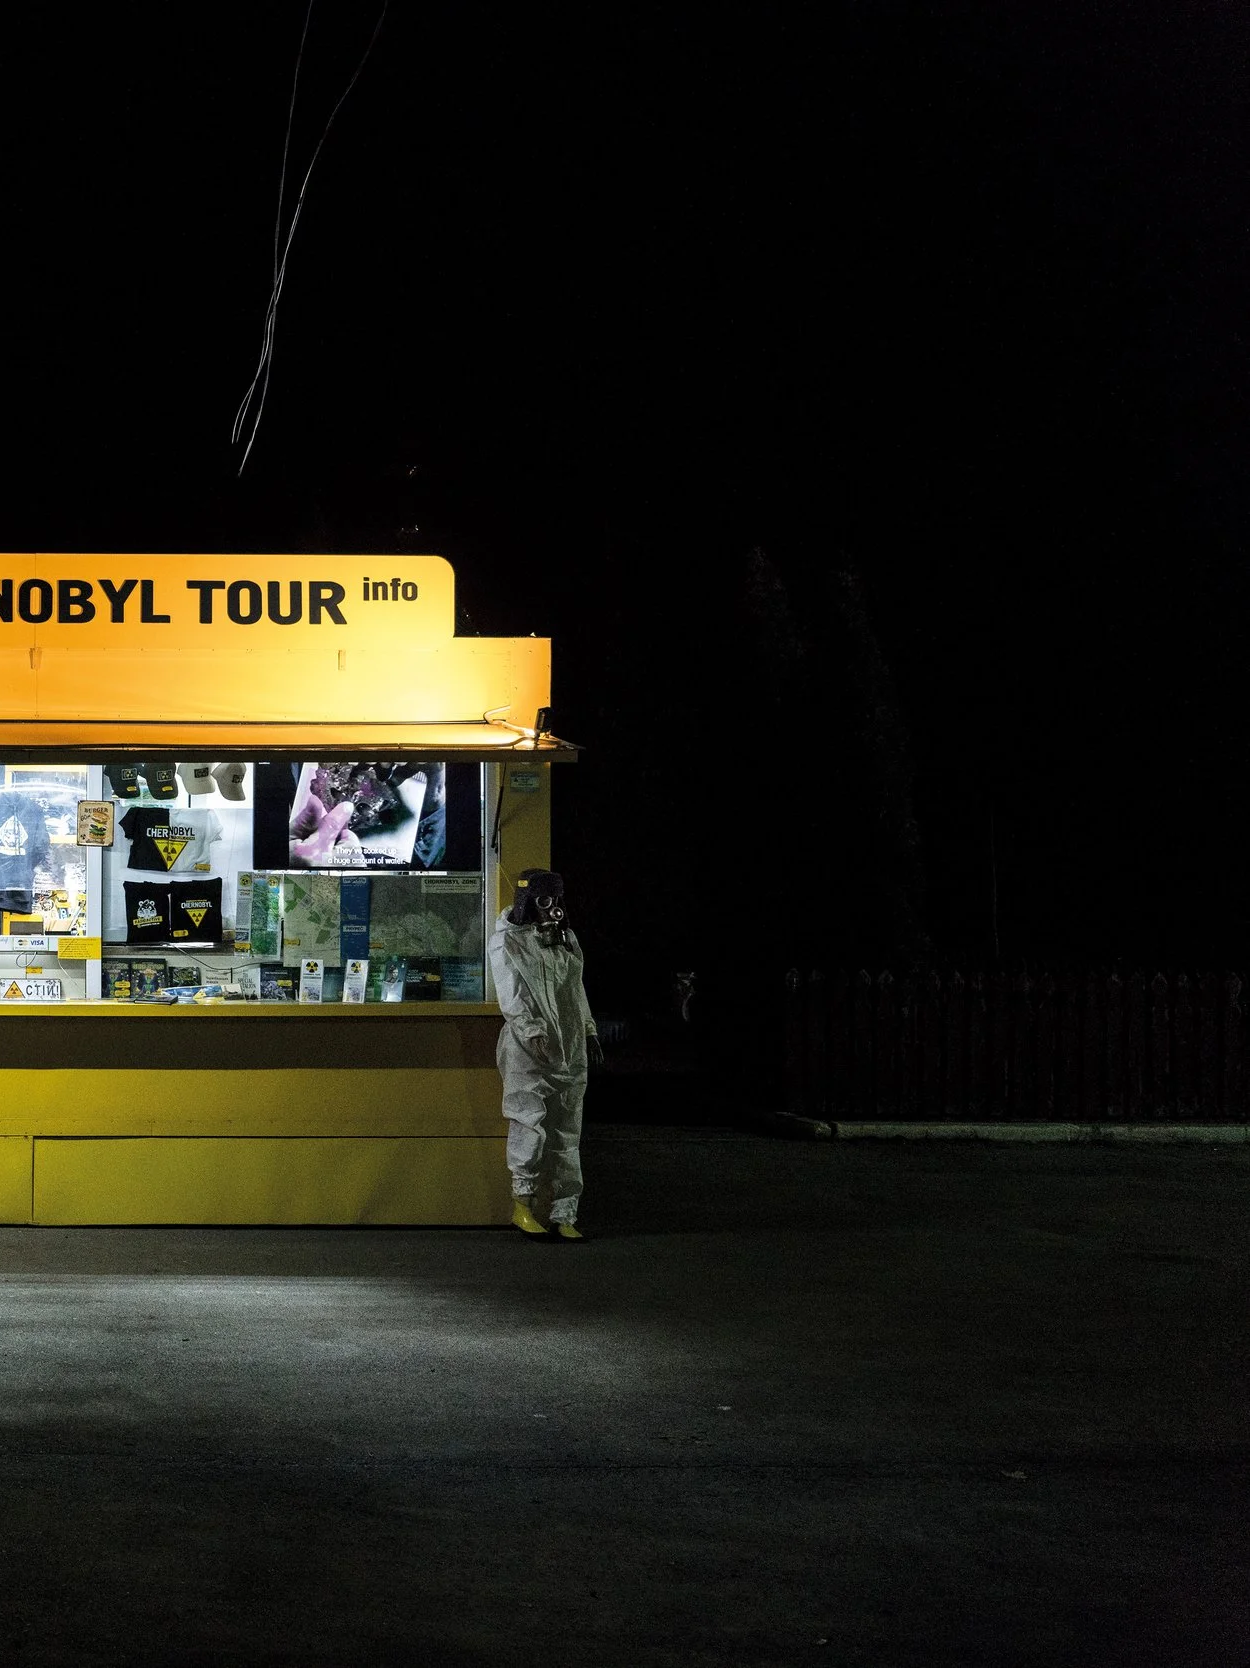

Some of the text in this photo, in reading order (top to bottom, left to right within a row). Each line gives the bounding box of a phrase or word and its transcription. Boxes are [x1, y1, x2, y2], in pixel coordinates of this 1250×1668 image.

[186, 580, 347, 625] TOUR
[363, 576, 418, 602] info
[146, 826, 196, 837] CHERNOBYL
[333, 857, 348, 866] huge
[180, 901, 213, 909] CHERNOBYL
